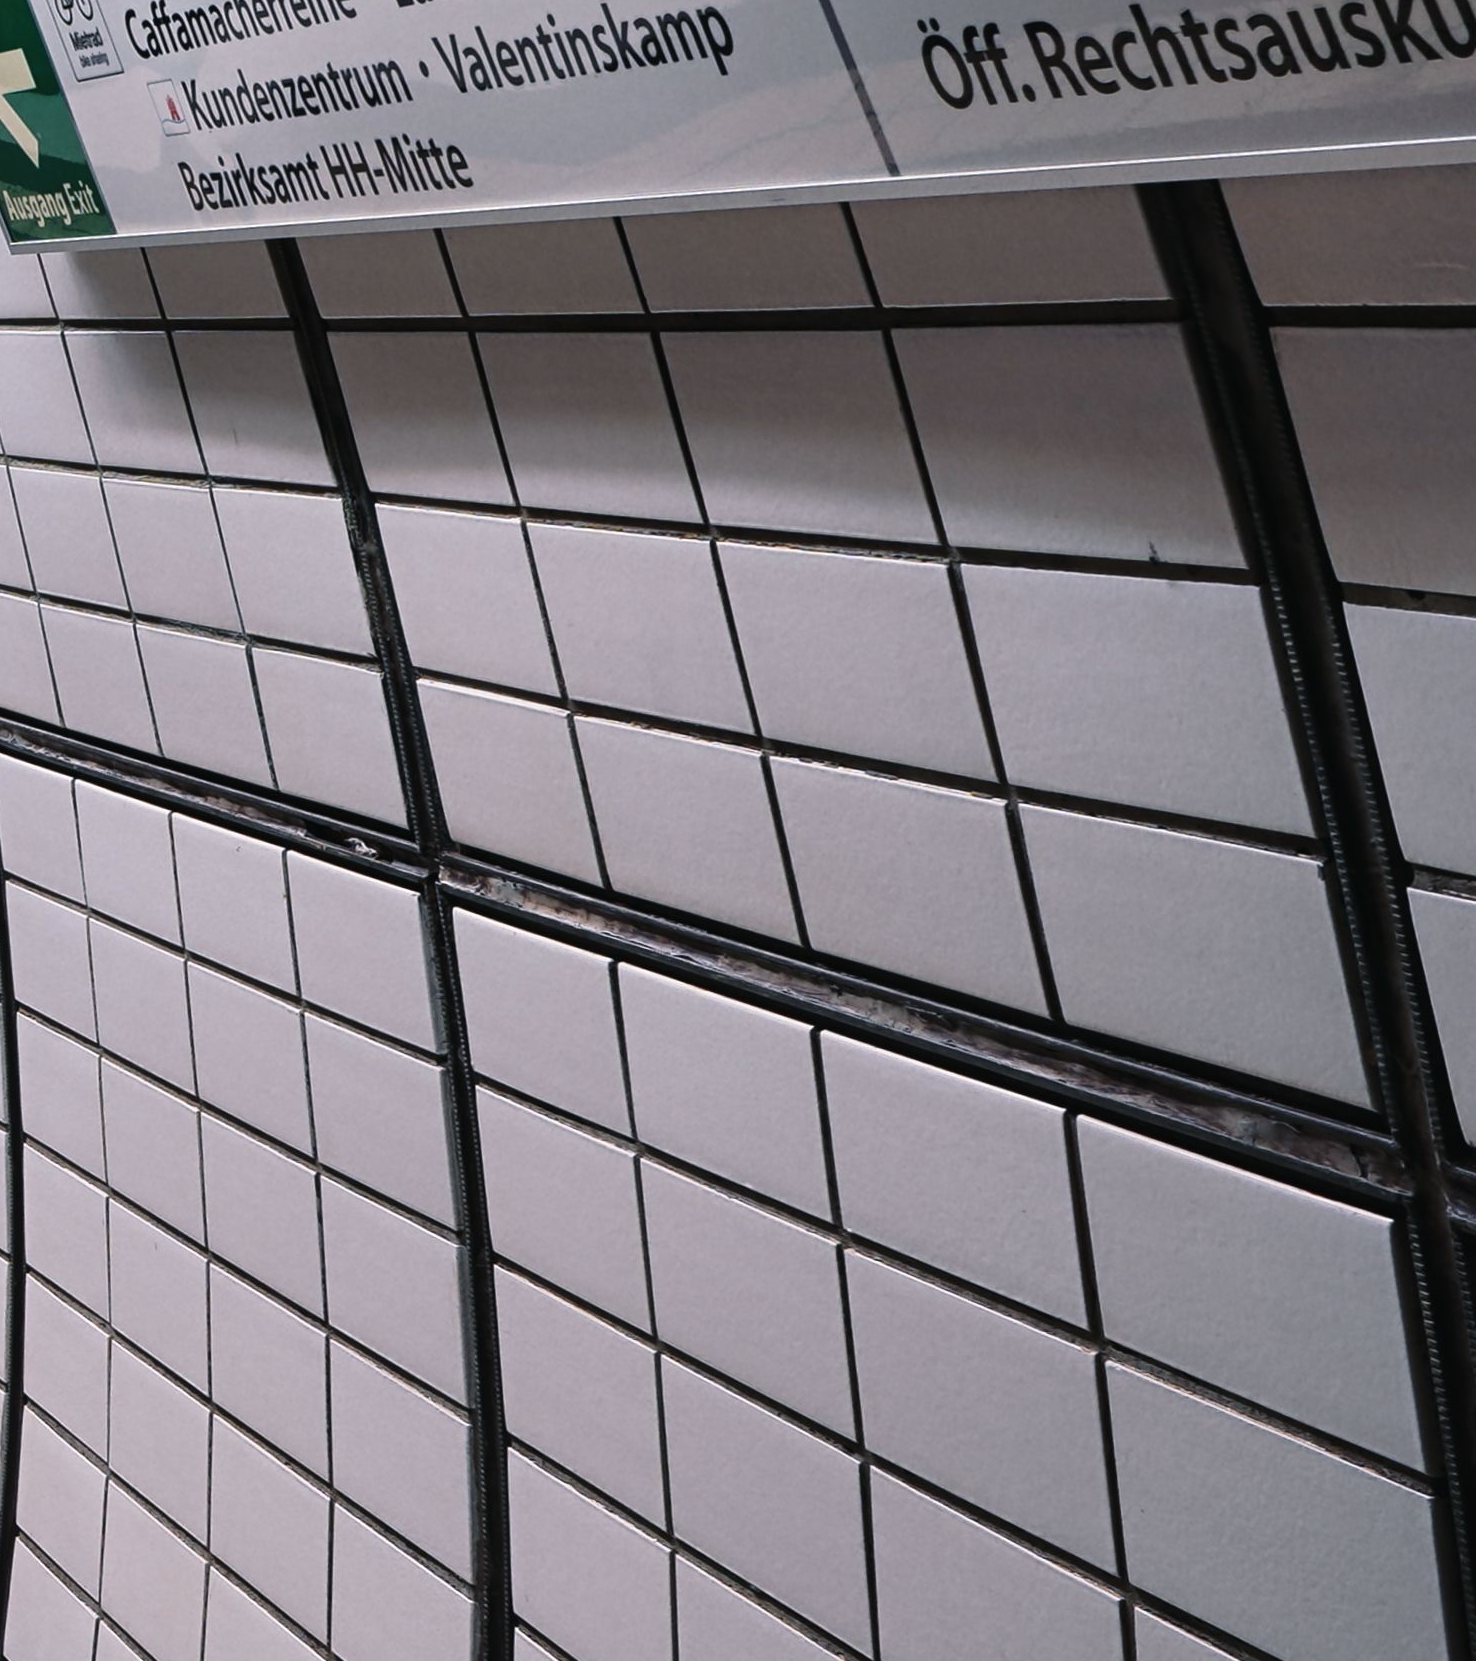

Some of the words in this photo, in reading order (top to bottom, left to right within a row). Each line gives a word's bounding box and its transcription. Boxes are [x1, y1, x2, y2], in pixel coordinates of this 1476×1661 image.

[181, 57, 414, 131] Kundenzentrum
[431, 2, 735, 95] Valentinskamp
[2, 188, 72, 228] Ausgang
[62, 180, 100, 216] Exit
[178, 151, 331, 212] Bezirksamt
[321, 133, 475, 202] HH-Mitte
